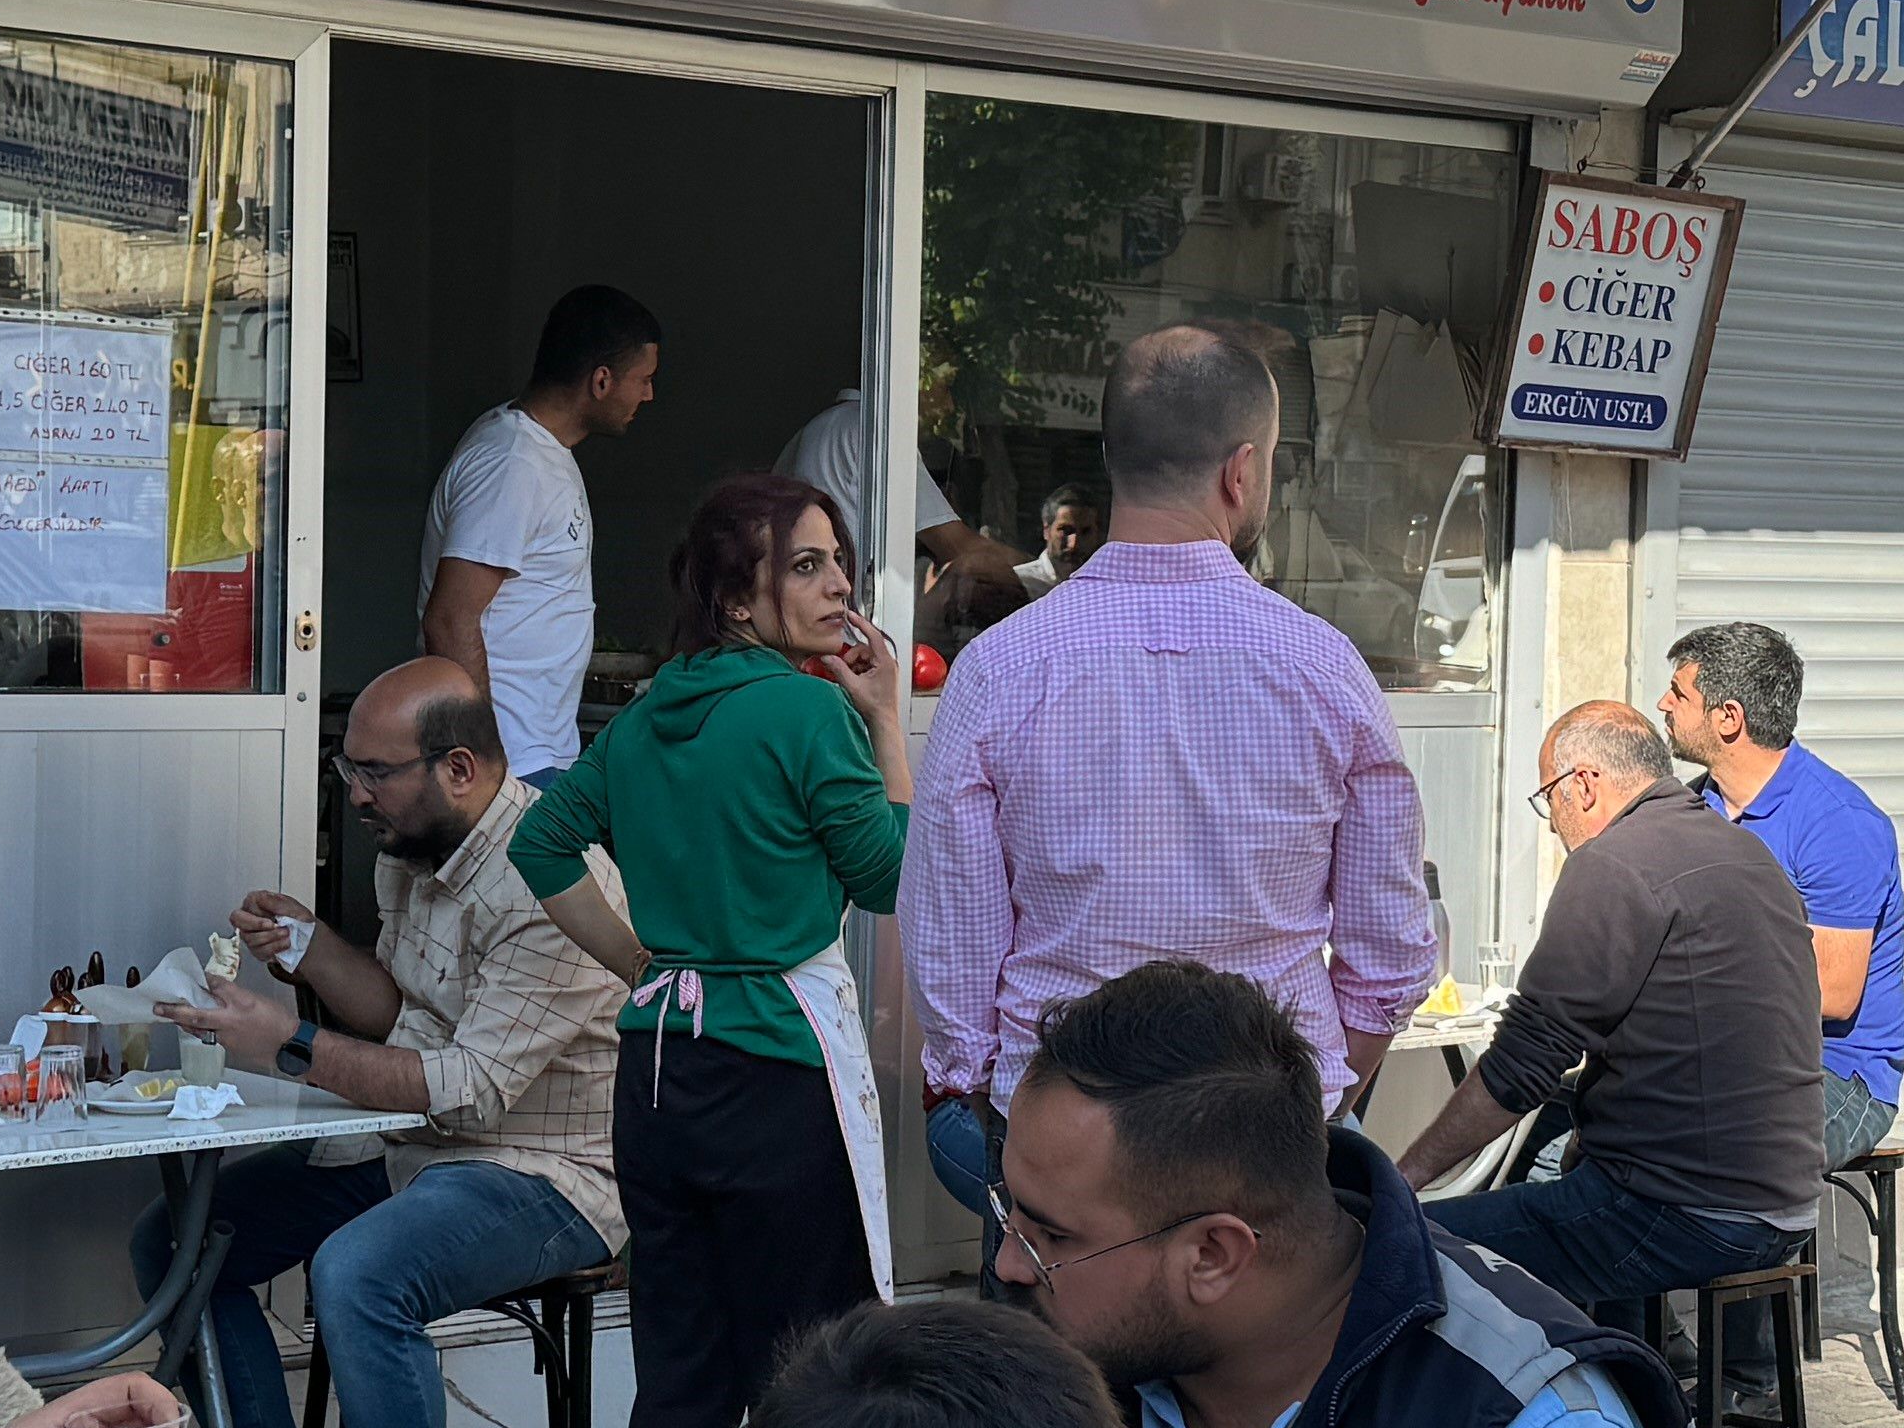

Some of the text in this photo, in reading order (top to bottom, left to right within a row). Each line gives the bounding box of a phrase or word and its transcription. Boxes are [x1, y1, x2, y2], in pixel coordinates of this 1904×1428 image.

[1549, 199, 1707, 277] SABOŞ
[1564, 267, 1676, 321] CİĞER
[1549, 329, 1672, 373] KEBAP
[78, 360, 111, 378] 160
[117, 363, 140, 380] TL
[138, 401, 161, 416] TL
[1523, 391, 1653, 424] ERGÜN USTA
[91, 428, 115, 440] 20
[126, 429, 150, 442] TL
